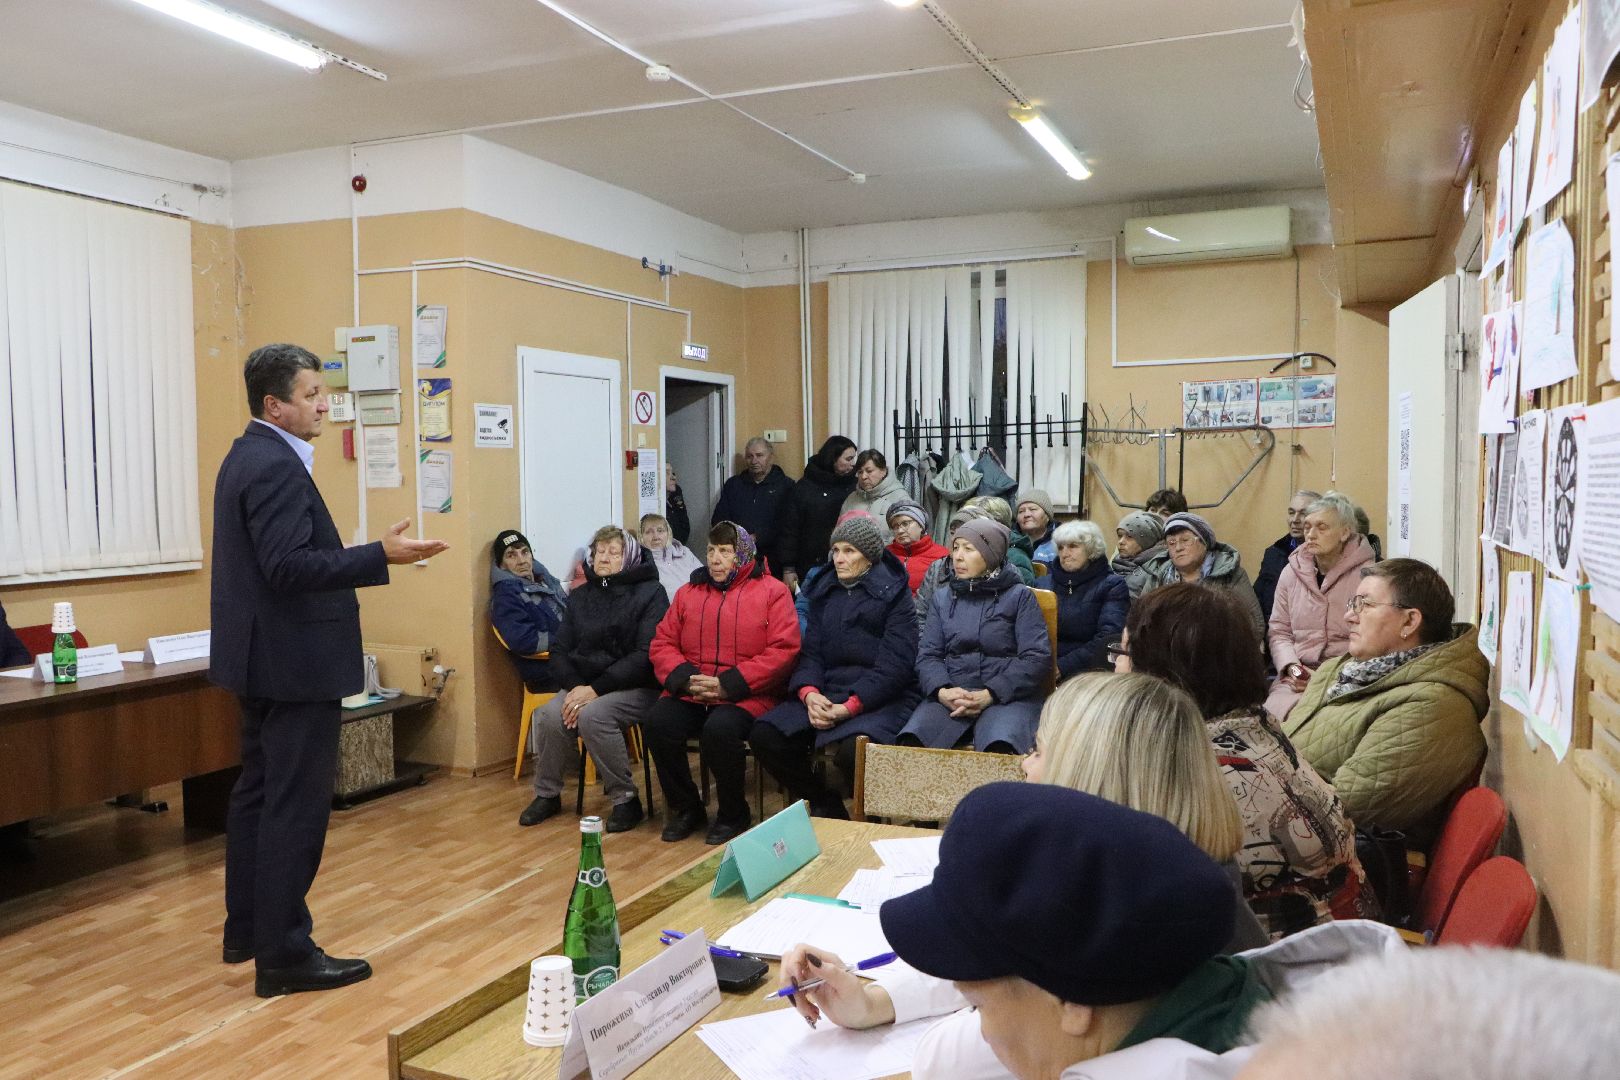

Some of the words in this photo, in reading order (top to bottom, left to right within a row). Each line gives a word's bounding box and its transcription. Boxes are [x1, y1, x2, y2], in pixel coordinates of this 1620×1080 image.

[684, 345, 706, 359] ВЫХОД
[634, 981, 670, 1009] Александр
[669, 955, 707, 986] Викторович
